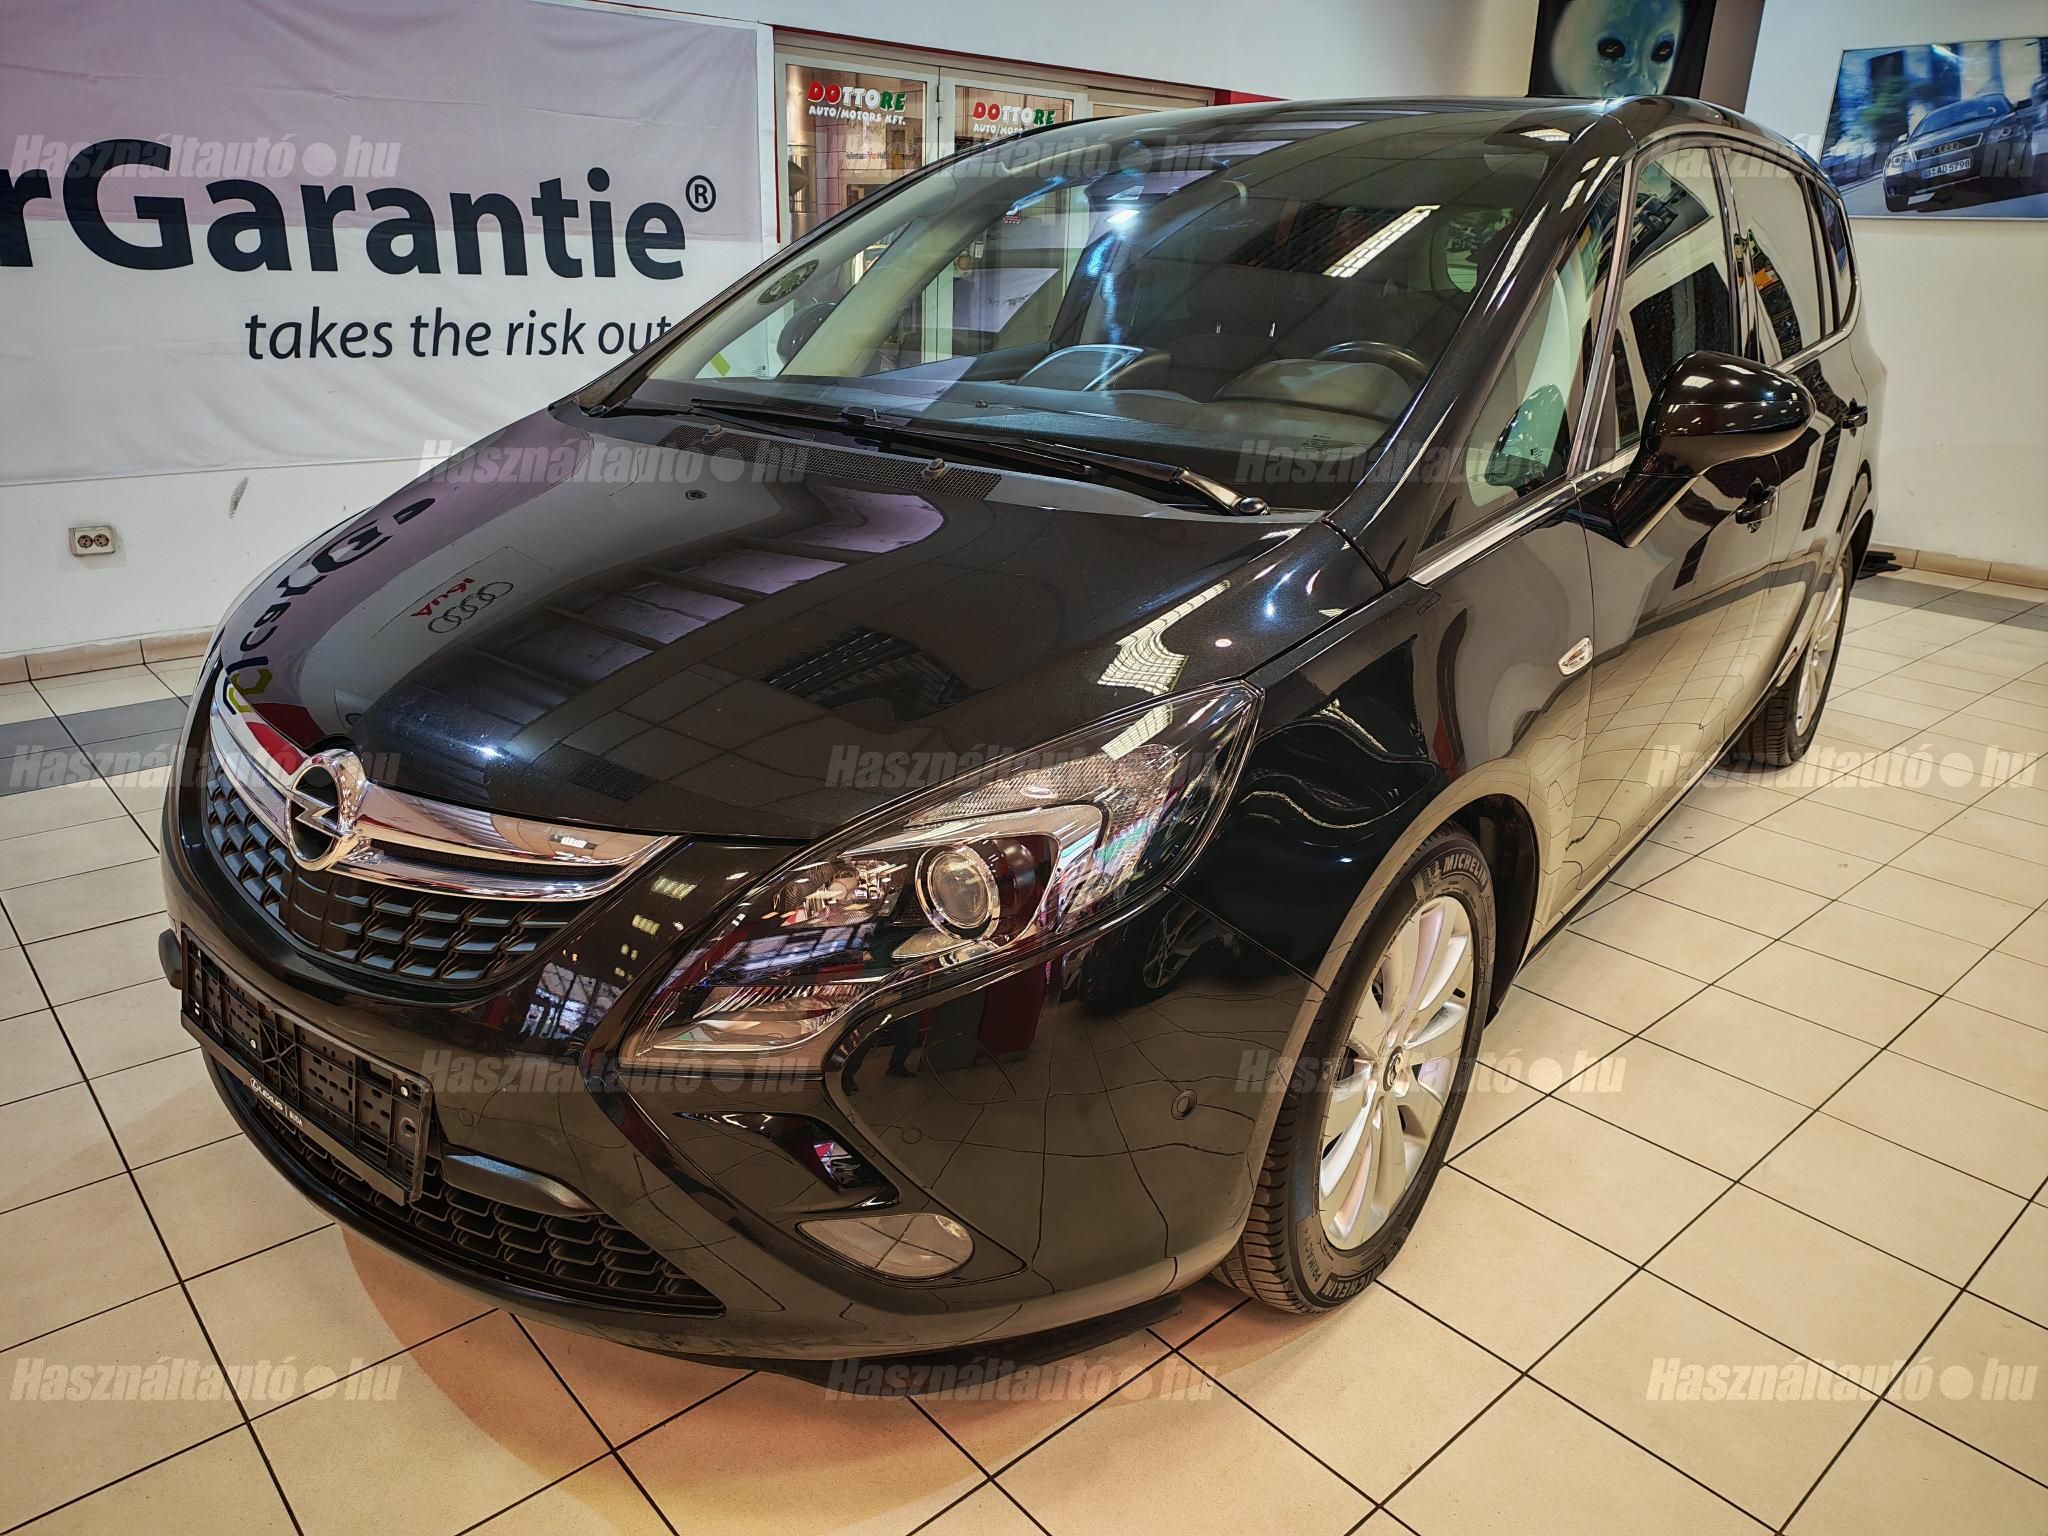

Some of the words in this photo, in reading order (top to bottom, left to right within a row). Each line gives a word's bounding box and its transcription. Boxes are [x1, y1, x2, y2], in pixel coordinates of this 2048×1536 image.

[807, 81, 906, 113] DOTTORE
[808, 105, 881, 123] AUTO/MOTORS
[973, 101, 1056, 127] DOTTORE
[245, 306, 393, 360] takes
[410, 307, 490, 357] the
[506, 309, 586, 356] risk
[598, 315, 672, 355] out
[1443, 853, 1488, 887] MICHELIN
